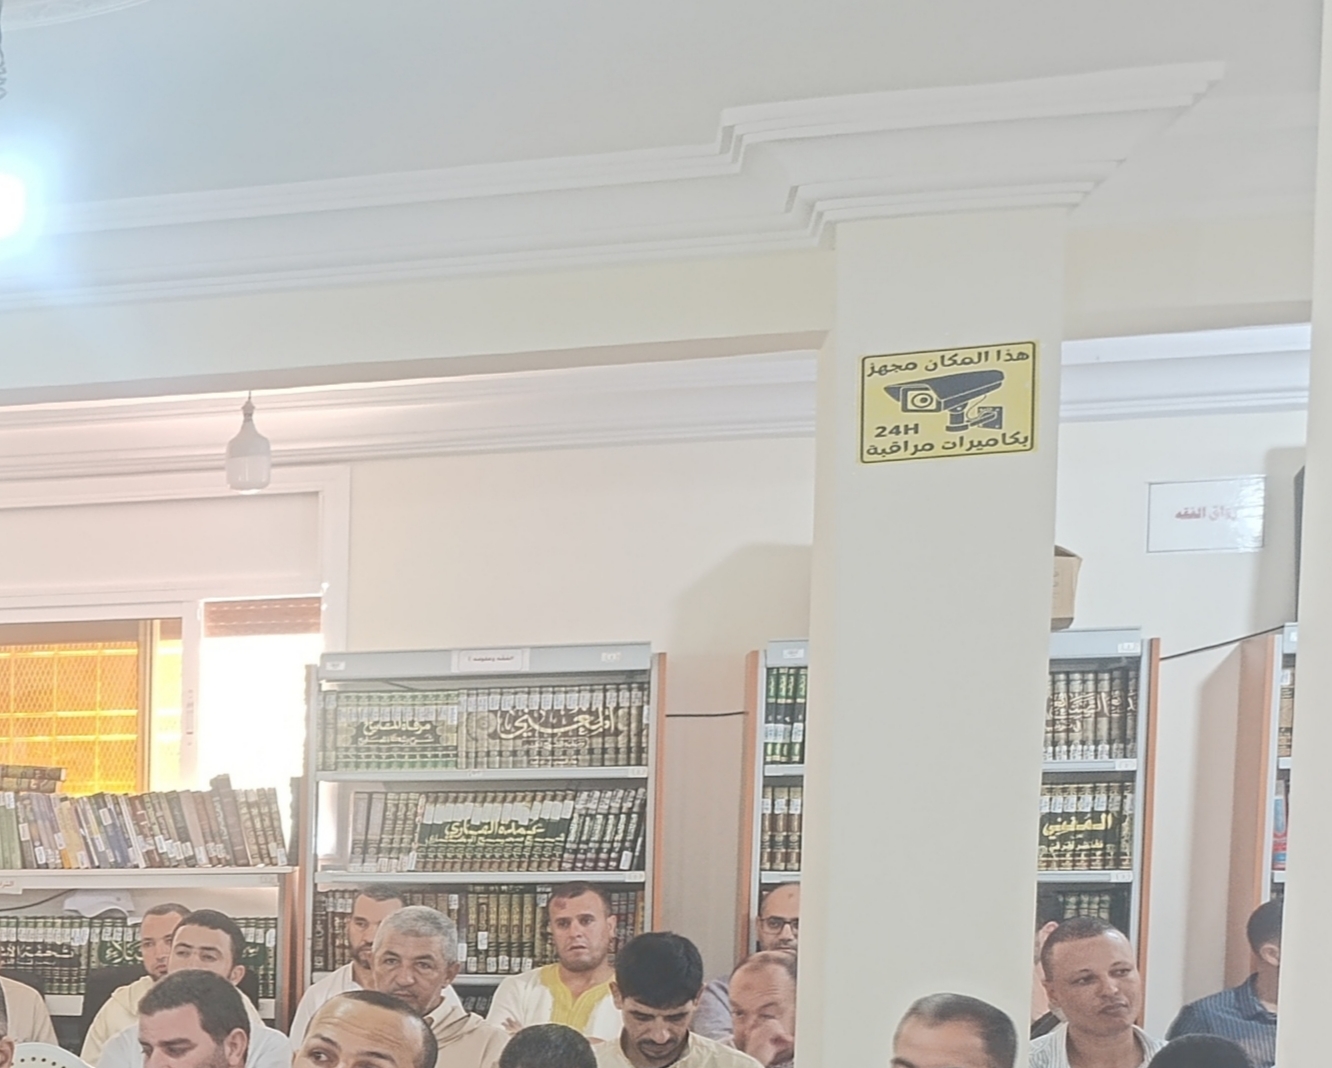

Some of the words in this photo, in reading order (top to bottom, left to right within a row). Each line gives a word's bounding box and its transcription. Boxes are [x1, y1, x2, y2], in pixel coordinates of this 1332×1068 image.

[924, 351, 990, 372] المكان
[996, 347, 1030, 363] هذا
[866, 361, 918, 377] مجهز
[874, 423, 920, 438] 24H
[865, 440, 935, 458] مراقبة
[941, 430, 1029, 453] بكاميرات
[1174, 506, 1207, 520] الفقه
[1042, 812, 1113, 840] المغني
